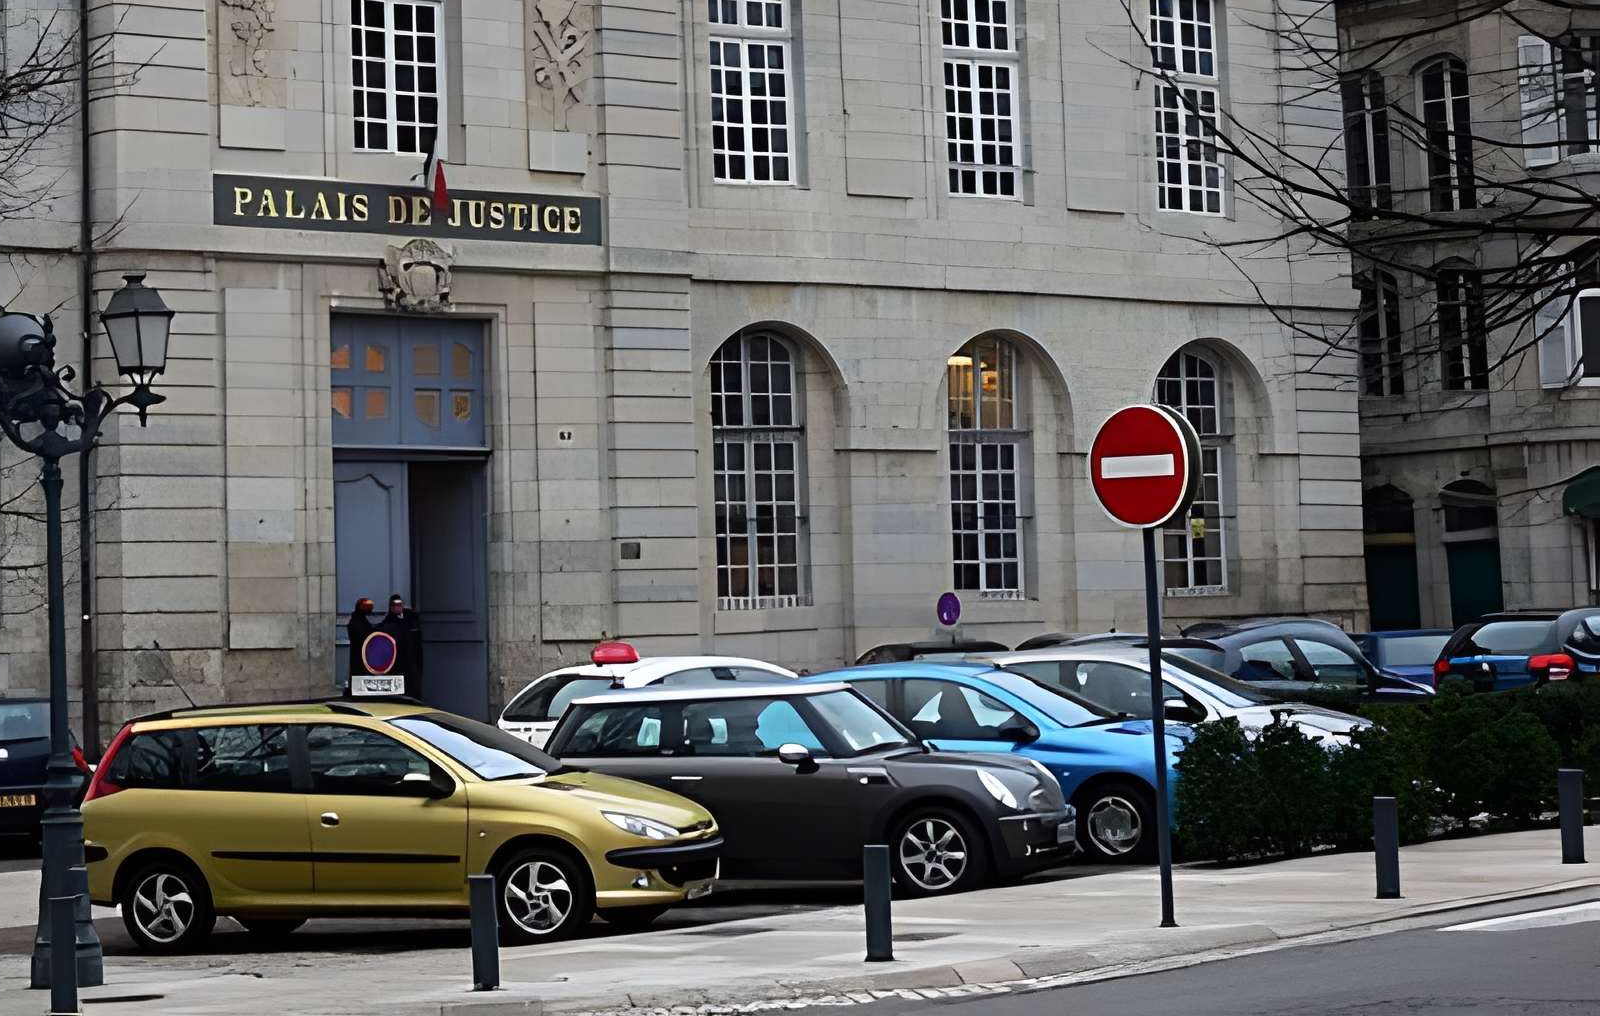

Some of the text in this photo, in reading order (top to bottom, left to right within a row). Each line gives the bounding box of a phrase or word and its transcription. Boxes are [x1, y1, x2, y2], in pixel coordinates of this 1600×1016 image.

[233, 186, 582, 234] PALAIS DE JUSTICE
